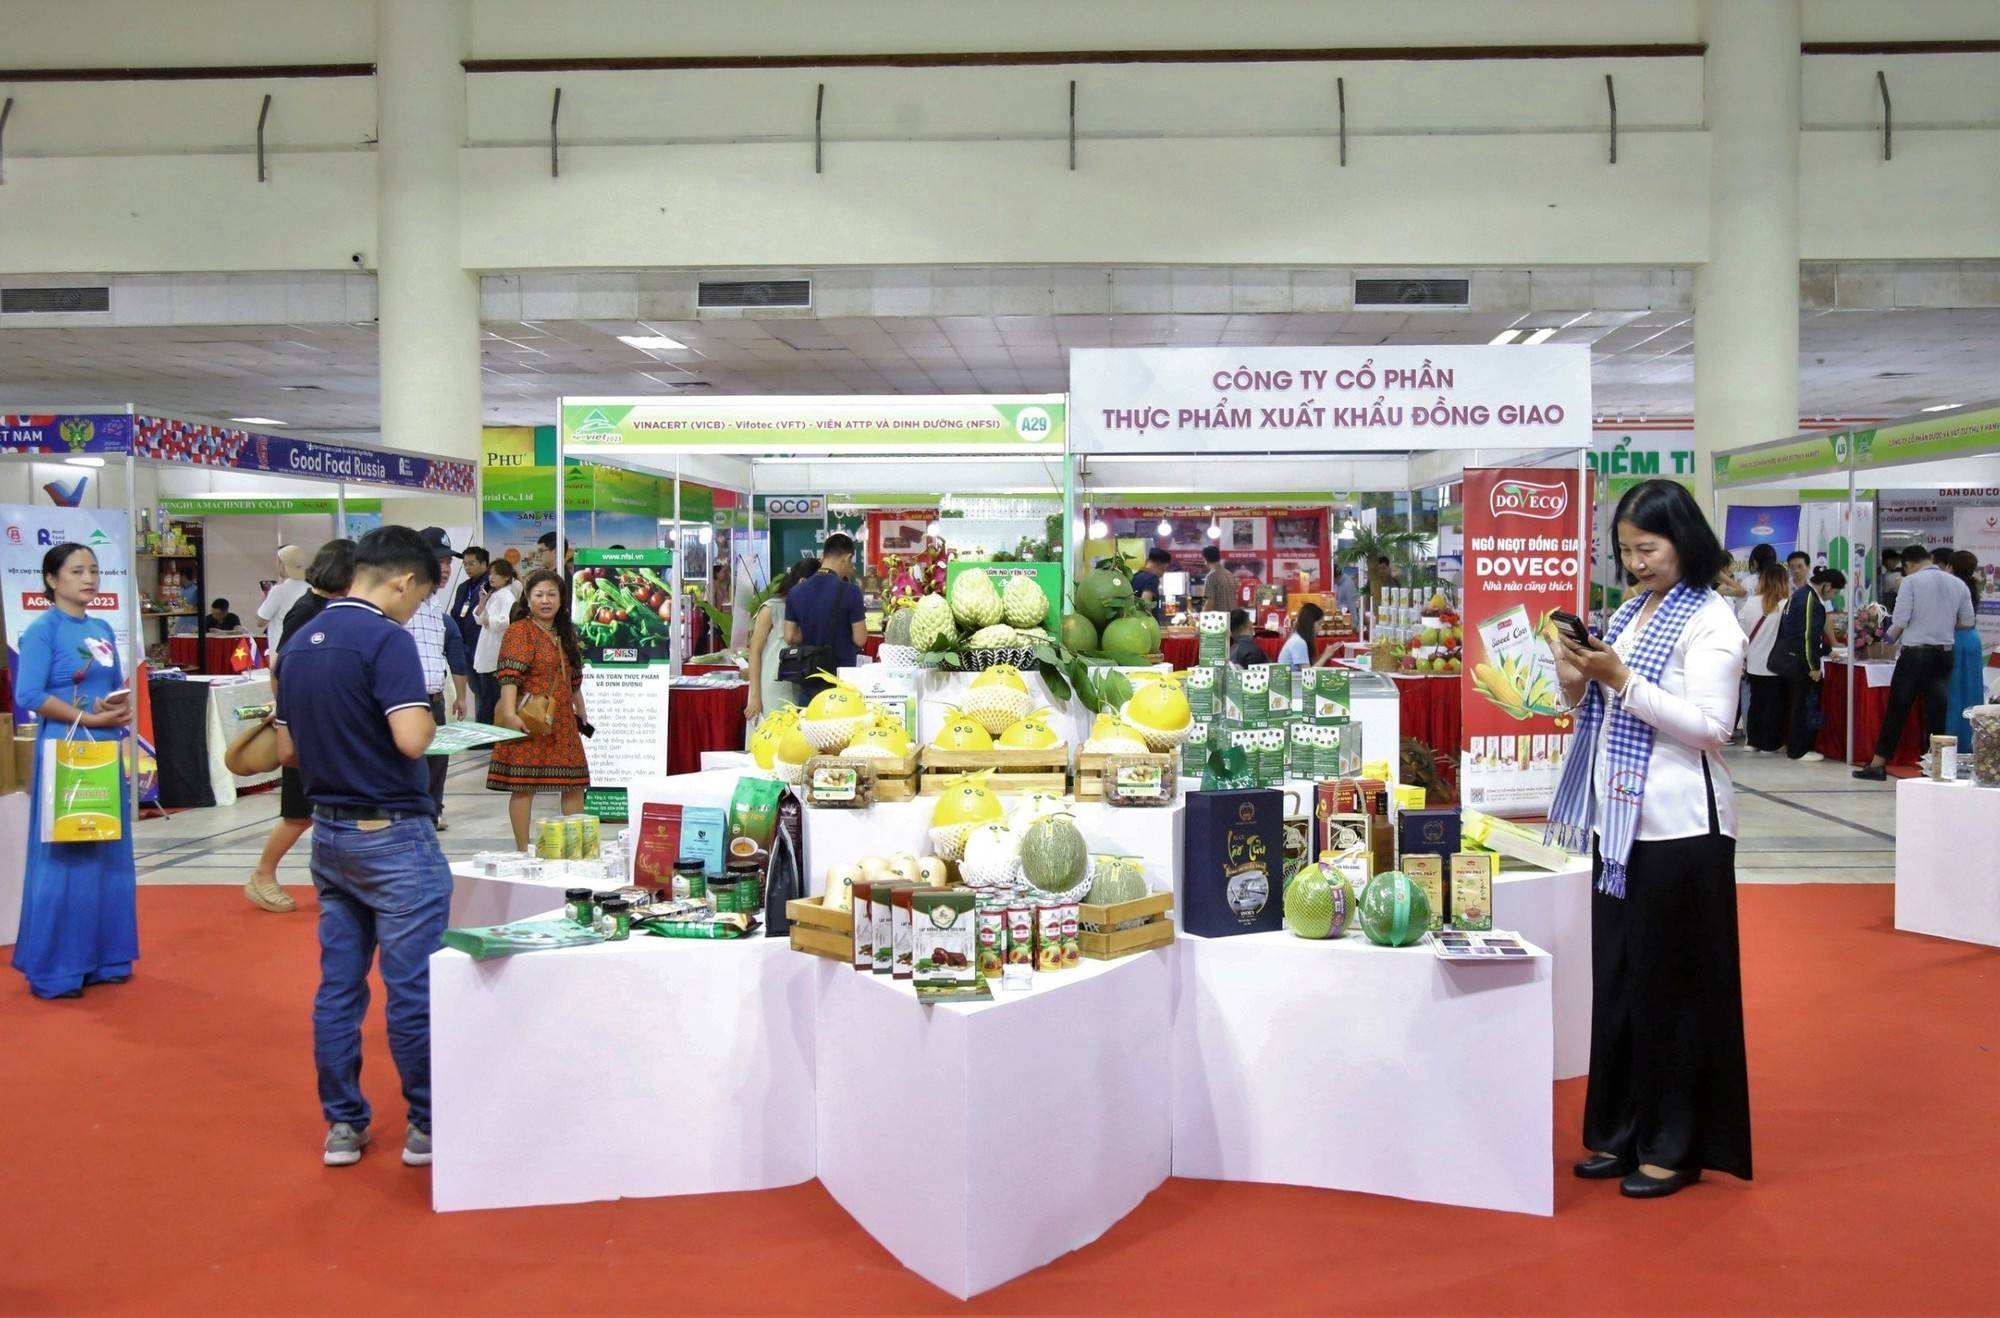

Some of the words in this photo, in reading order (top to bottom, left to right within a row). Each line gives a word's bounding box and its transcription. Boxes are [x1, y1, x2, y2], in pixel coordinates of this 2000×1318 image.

[1212, 364, 1293, 391] CÔNG
[1300, 369, 1326, 390] TY
[1335, 358, 1376, 390] CỔ
[1384, 358, 1455, 389] PHẦN
[1102, 408, 1170, 435] THỰC
[1178, 397, 1252, 429] PHẨM
[1260, 399, 1326, 428] XUẤT
[1334, 396, 1404, 427] KHẨU
[1411, 396, 1490, 427] ĐỒNG
[1497, 404, 1565, 426] GIAO
[633, 420, 687, 430] VINACERT
[690, 420, 726, 431] (VICB)
[735, 420, 773, 430] Vifotec
[775, 420, 806, 431] (VFT)
[816, 418, 842, 430] VIỆN
[845, 420, 873, 429] ATTP
[876, 418, 889, 429] VÀ
[893, 420, 920, 429] DINH
[923, 418, 964, 429] DƯỠNG
[966, 420, 1001, 431] (NFSI)
[1021, 417, 1047, 432] A29
[13, 430, 43, 442] NAM
[290, 448, 322, 472] Good
[354, 458, 386, 479] Russia
[202, 500, 257, 509] MACHINERY
[769, 499, 820, 514] OCOP
[1495, 487, 1563, 509] DOVECO
[1471, 535, 1495, 551] NGÔ
[1497, 537, 1526, 554] NGỌT
[1561, 537, 1586, 551] GIA
[1476, 557, 1578, 577] DOVECO
[1482, 580, 1502, 592] Nhà
[1503, 581, 1523, 592] nào
[1524, 580, 1547, 594] cũng
[1548, 581, 1573, 592] thích
